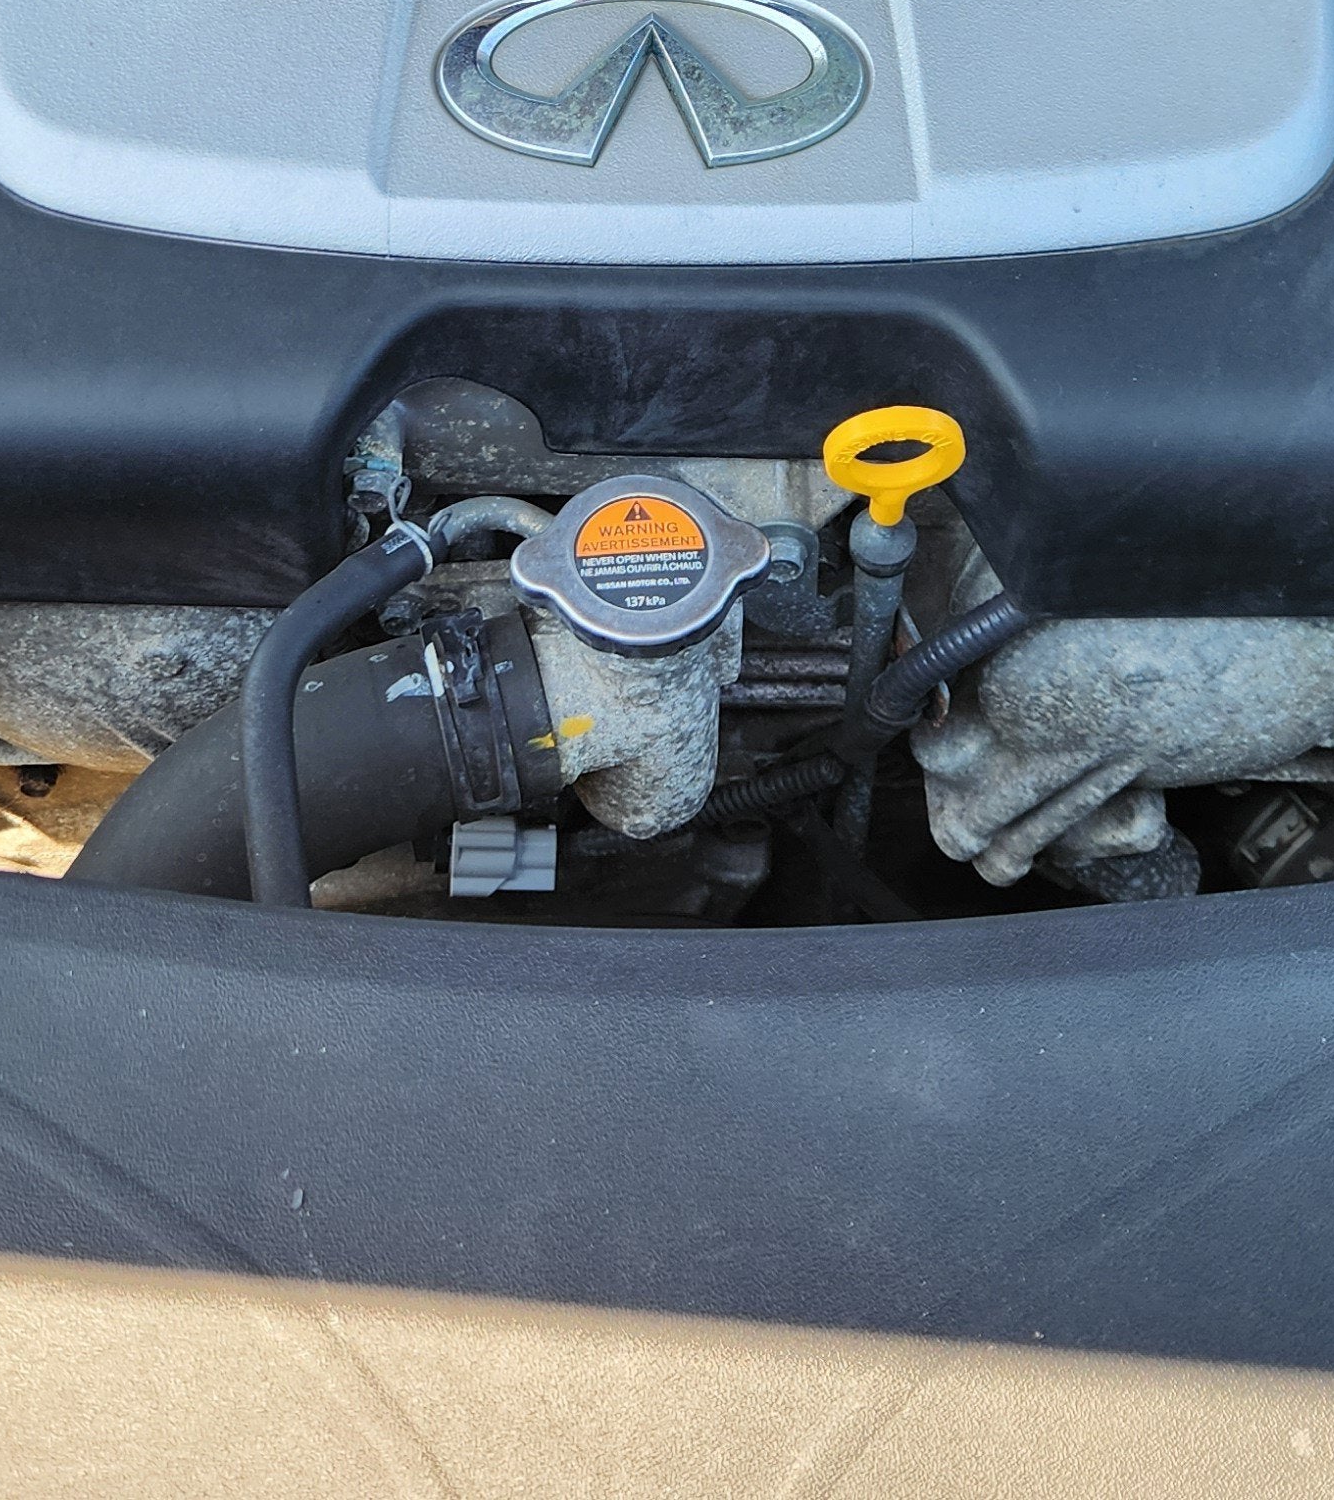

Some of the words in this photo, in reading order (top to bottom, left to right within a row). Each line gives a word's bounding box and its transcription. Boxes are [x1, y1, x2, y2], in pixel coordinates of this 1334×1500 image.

[833, 429, 907, 465] ENGINE
[599, 522, 678, 537] WARNING
[582, 536, 698, 552] AVERTISSEMENT
[582, 556, 615, 567] NEVER
[616, 554, 644, 565] OPEN
[646, 552, 676, 563] WHEN
[677, 551, 701, 561] HOT.
[580, 567, 594, 577] NE
[593, 565, 626, 577] JAMAIS
[627, 563, 661, 573] OUVRIR
[669, 561, 704, 571] CHAUD.
[596, 581, 627, 590] NISSAN
[628, 579, 656, 588] MOTOR
[625, 596, 645, 608] 137
[646, 595, 666, 606] kPa
